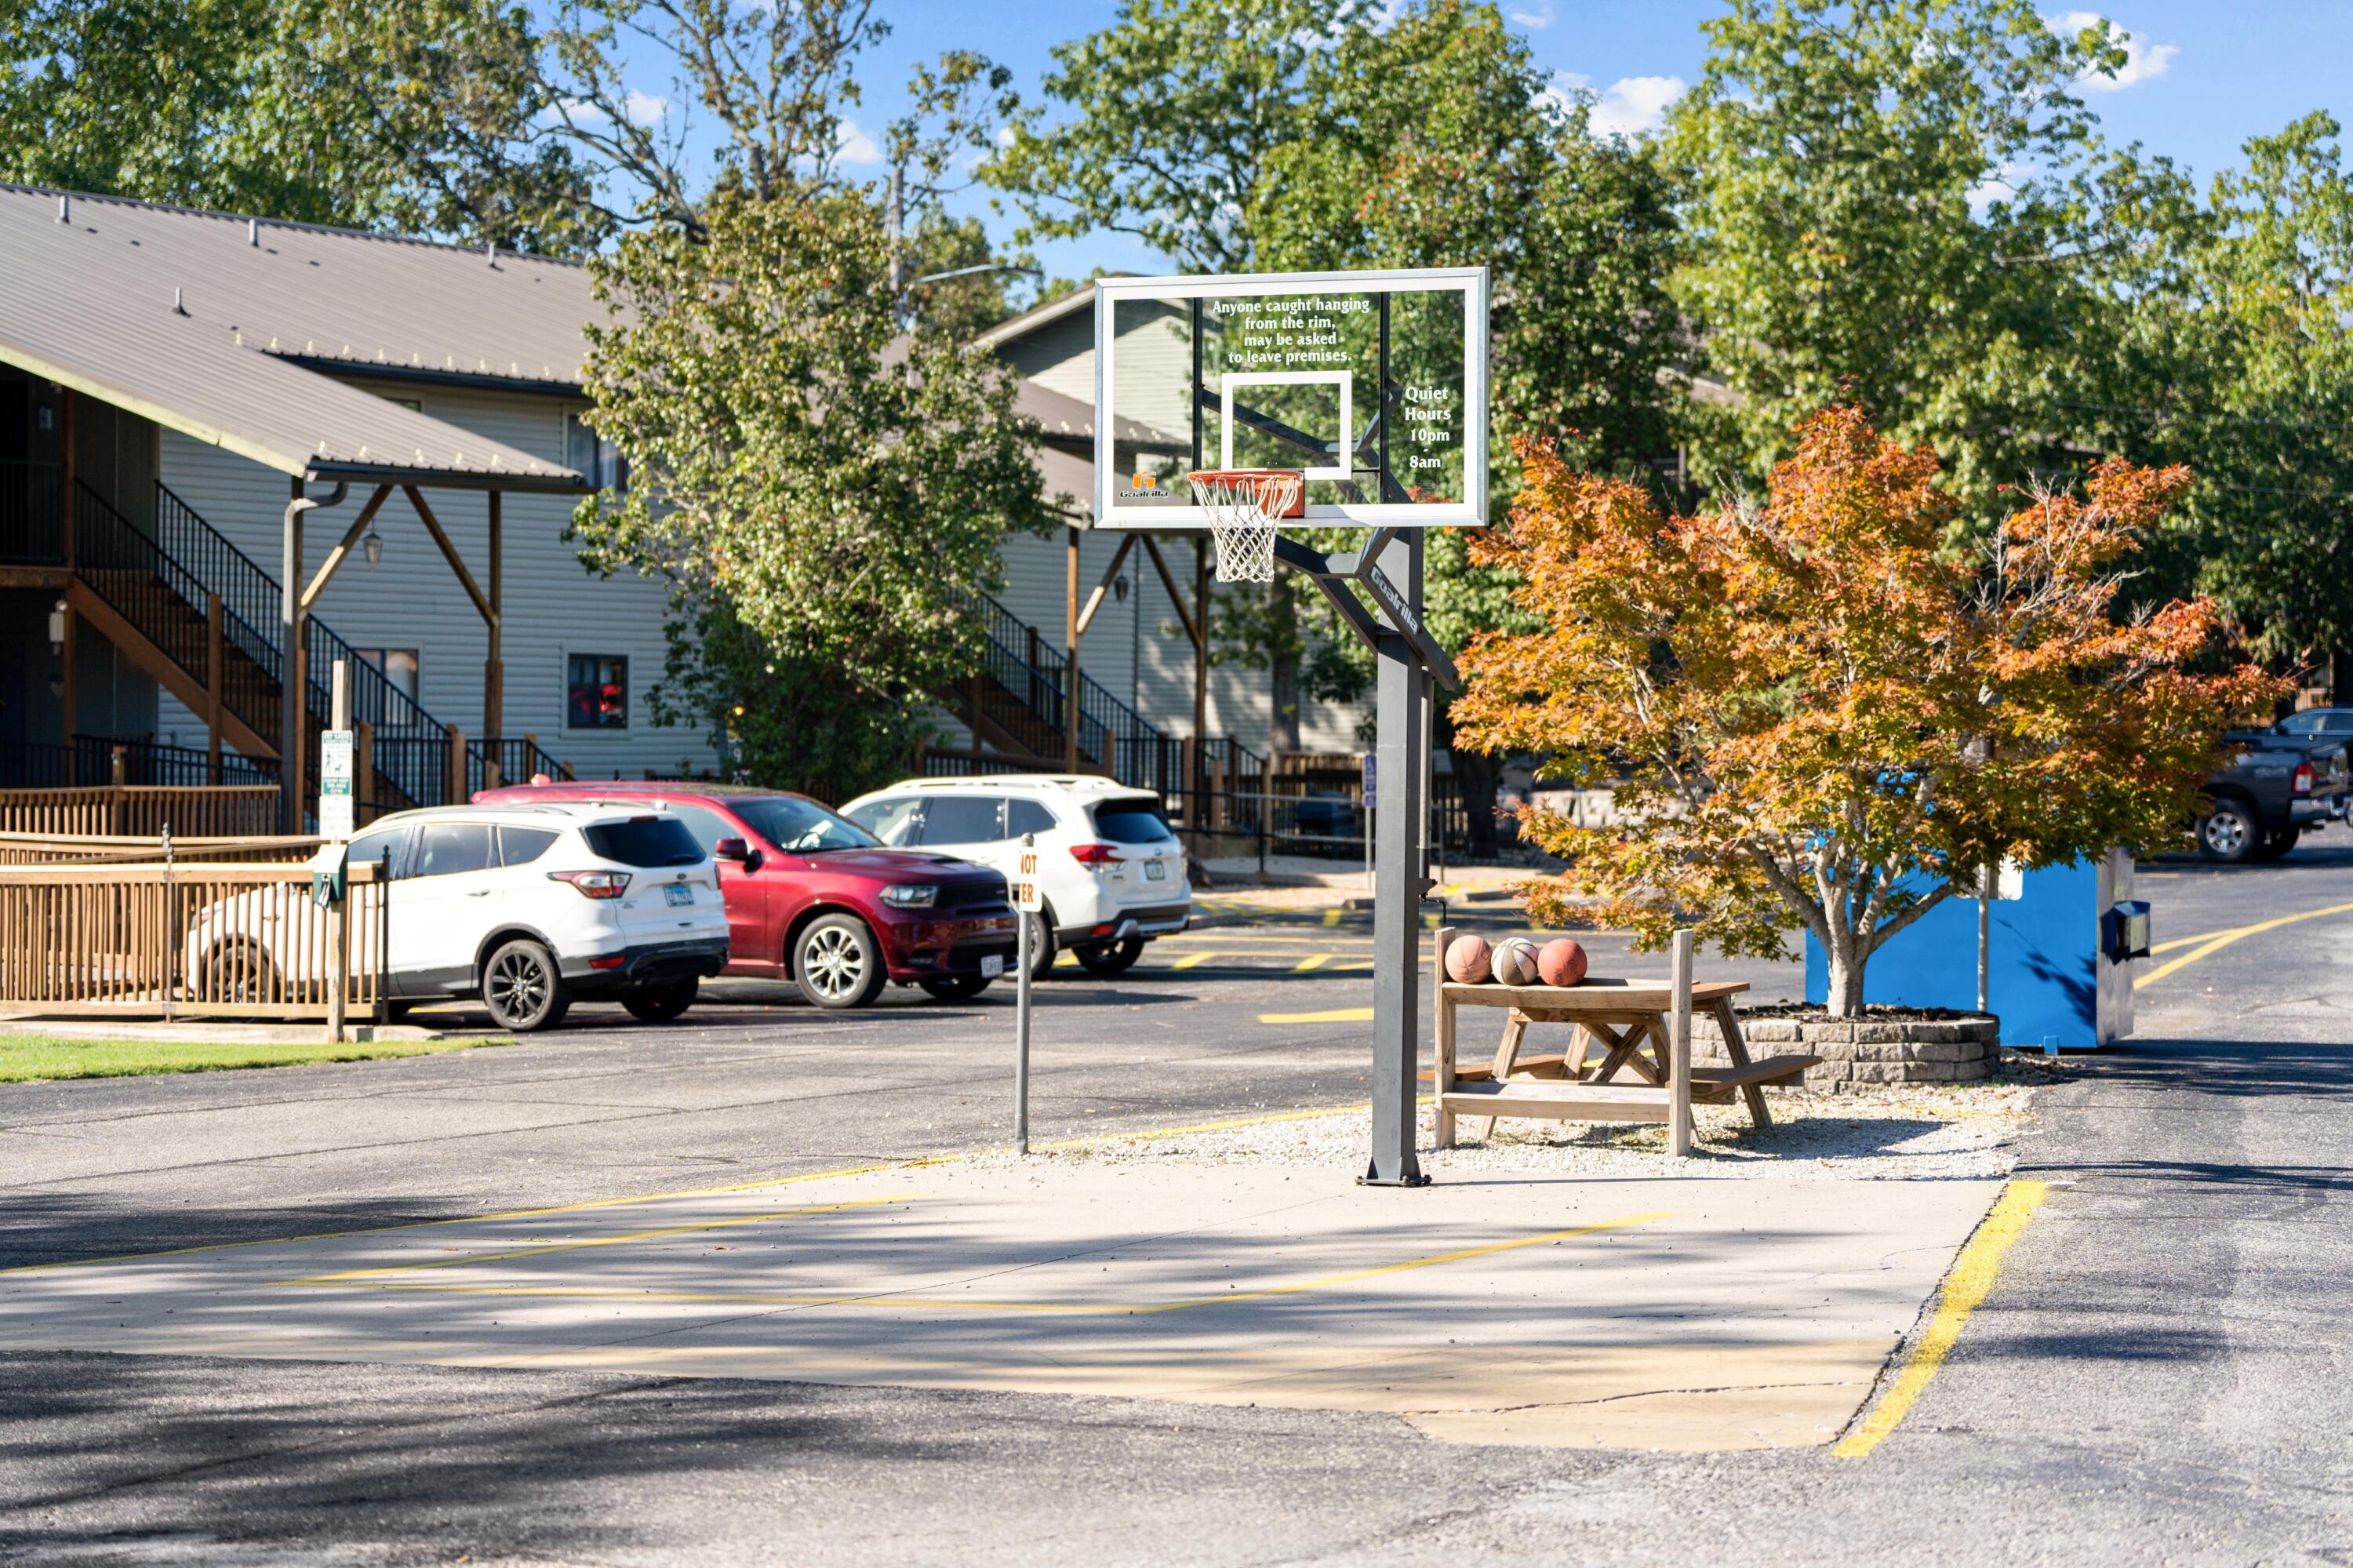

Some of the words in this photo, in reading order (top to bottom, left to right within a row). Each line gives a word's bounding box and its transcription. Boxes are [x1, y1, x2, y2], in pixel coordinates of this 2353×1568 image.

[1212, 300, 1262, 316] Anyone
[1265, 298, 1312, 315] caught
[1315, 297, 1370, 314] hanging
[1245, 317, 1278, 330] from
[1282, 316, 1304, 329] the
[1307, 315, 1336, 330] rim,
[1244, 337, 1273, 349] may
[1276, 333, 1293, 346] be
[1297, 331, 1337, 345] asked
[1228, 352, 1243, 363] to
[1246, 350, 1282, 363] leave
[1286, 350, 1352, 365] premises.
[1405, 386, 1449, 403] Quiet
[1405, 407, 1452, 421] Hours
[1410, 428, 1450, 445] 10pm
[1409, 455, 1442, 468] 8am
[1371, 566, 1418, 635] Goalrilla
